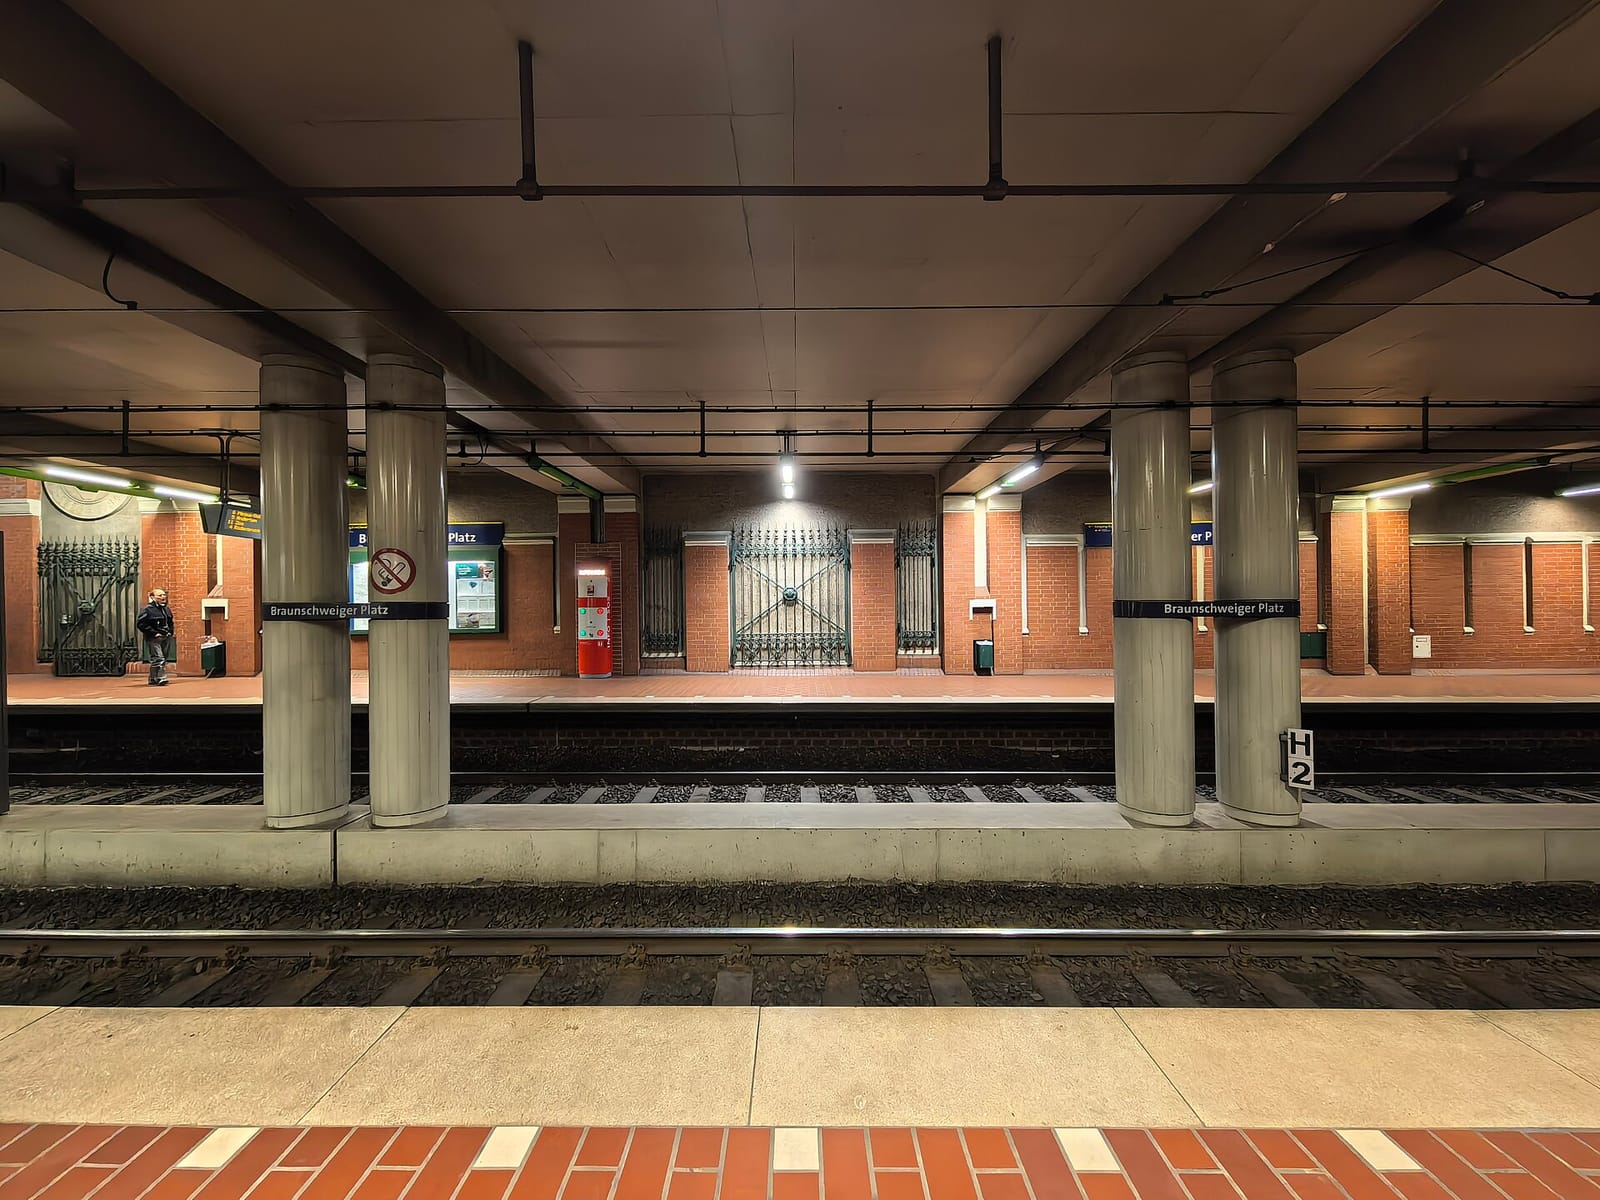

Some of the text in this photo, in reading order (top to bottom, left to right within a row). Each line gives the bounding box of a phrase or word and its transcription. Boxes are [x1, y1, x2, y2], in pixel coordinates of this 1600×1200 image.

[448, 532, 476, 542] Platz
[270, 604, 389, 618] Braunschweiger Platz
[1164, 602, 1285, 616] Braunschweiger Platz
[1290, 731, 1311, 756] H
[1291, 761, 1312, 785] 2
